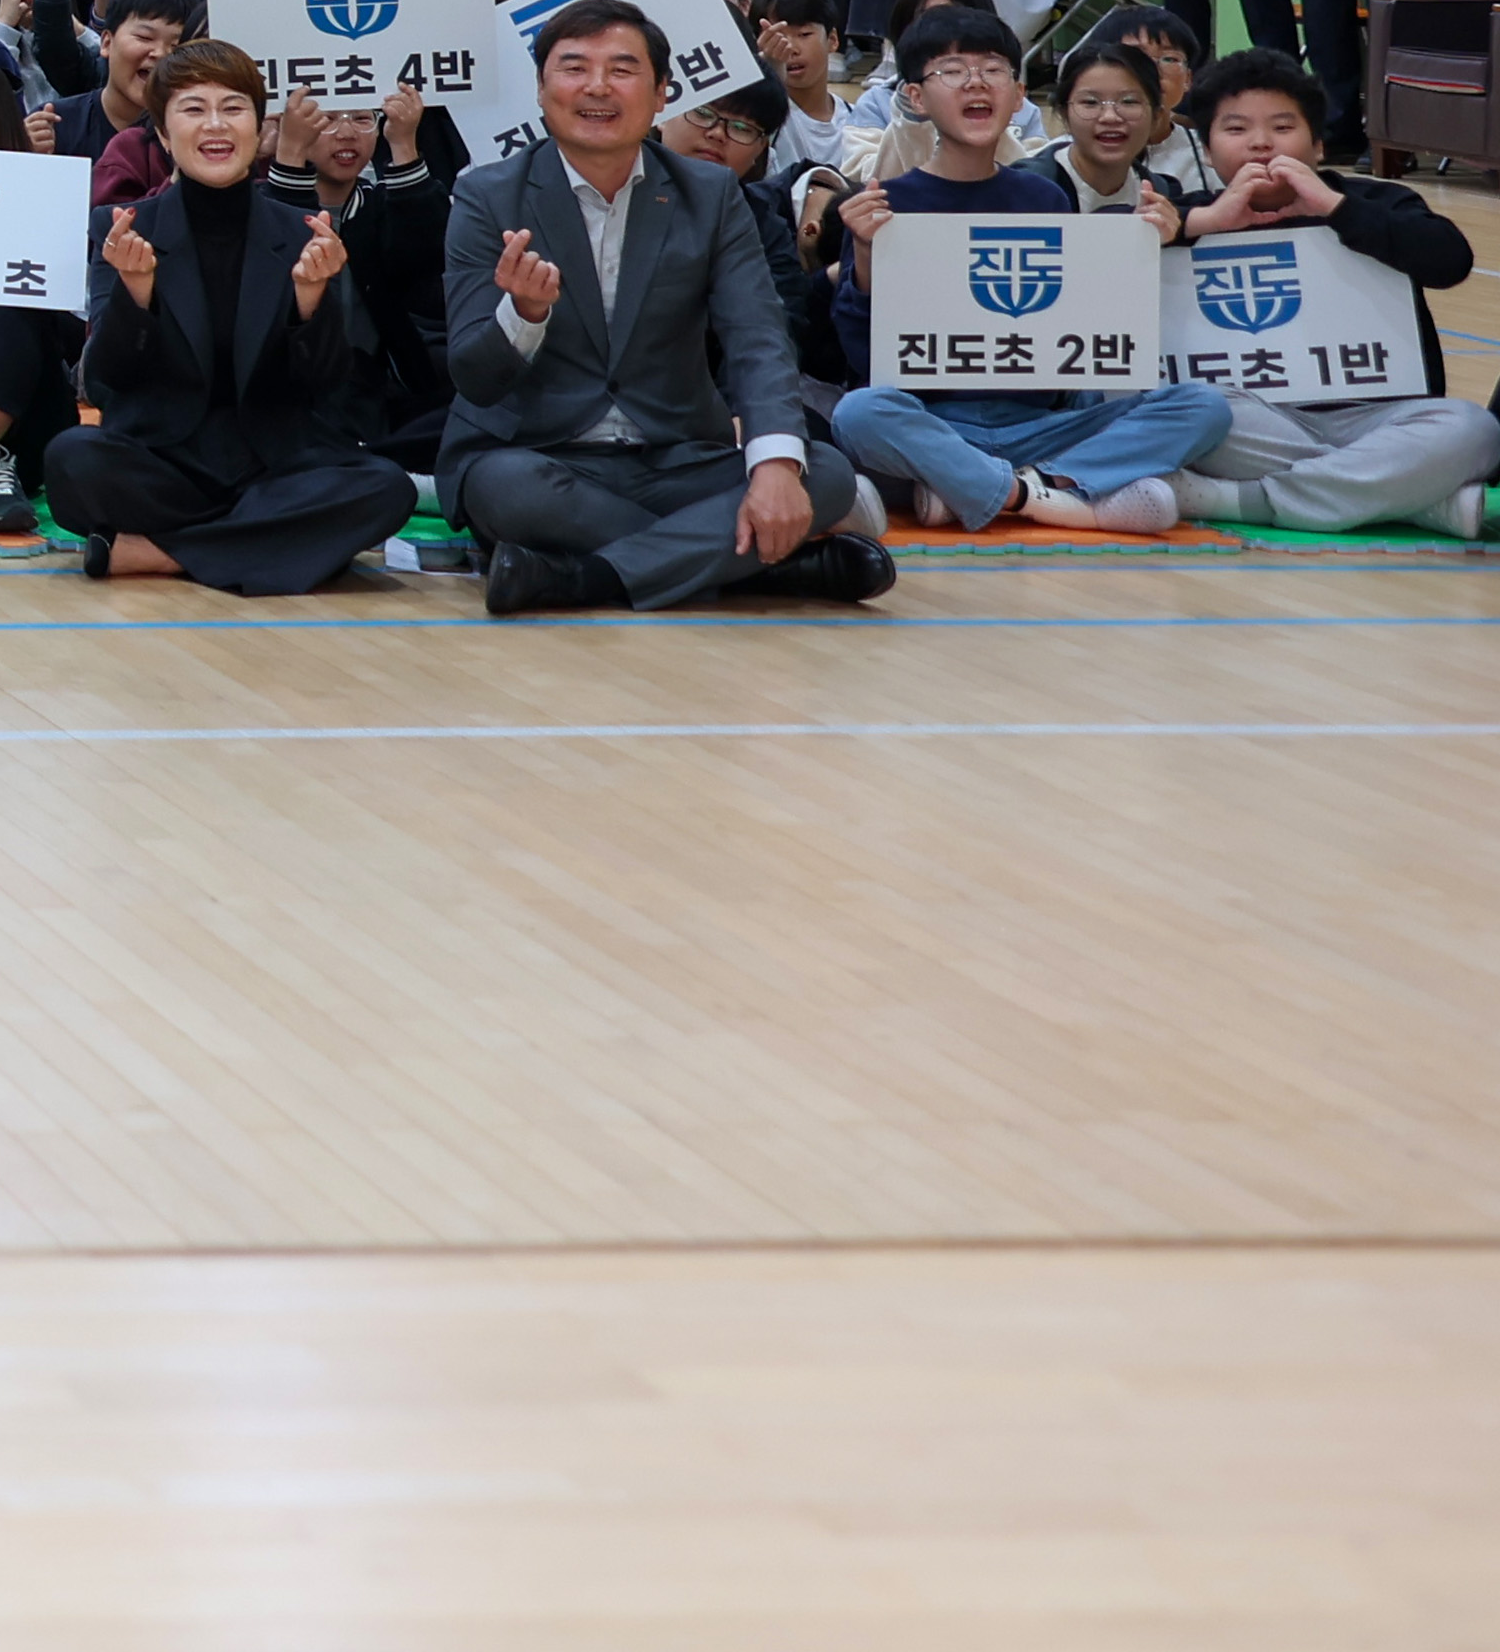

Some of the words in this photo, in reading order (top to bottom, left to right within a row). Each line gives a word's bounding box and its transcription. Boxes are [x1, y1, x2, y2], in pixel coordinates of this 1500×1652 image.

[397, 50, 475, 93] 4반
[969, 248, 1063, 282] 진도
[1193, 262, 1302, 301] 진도
[898, 333, 1035, 375] 진도초
[1056, 333, 1135, 376] 2반
[1308, 341, 1389, 386] 1반
